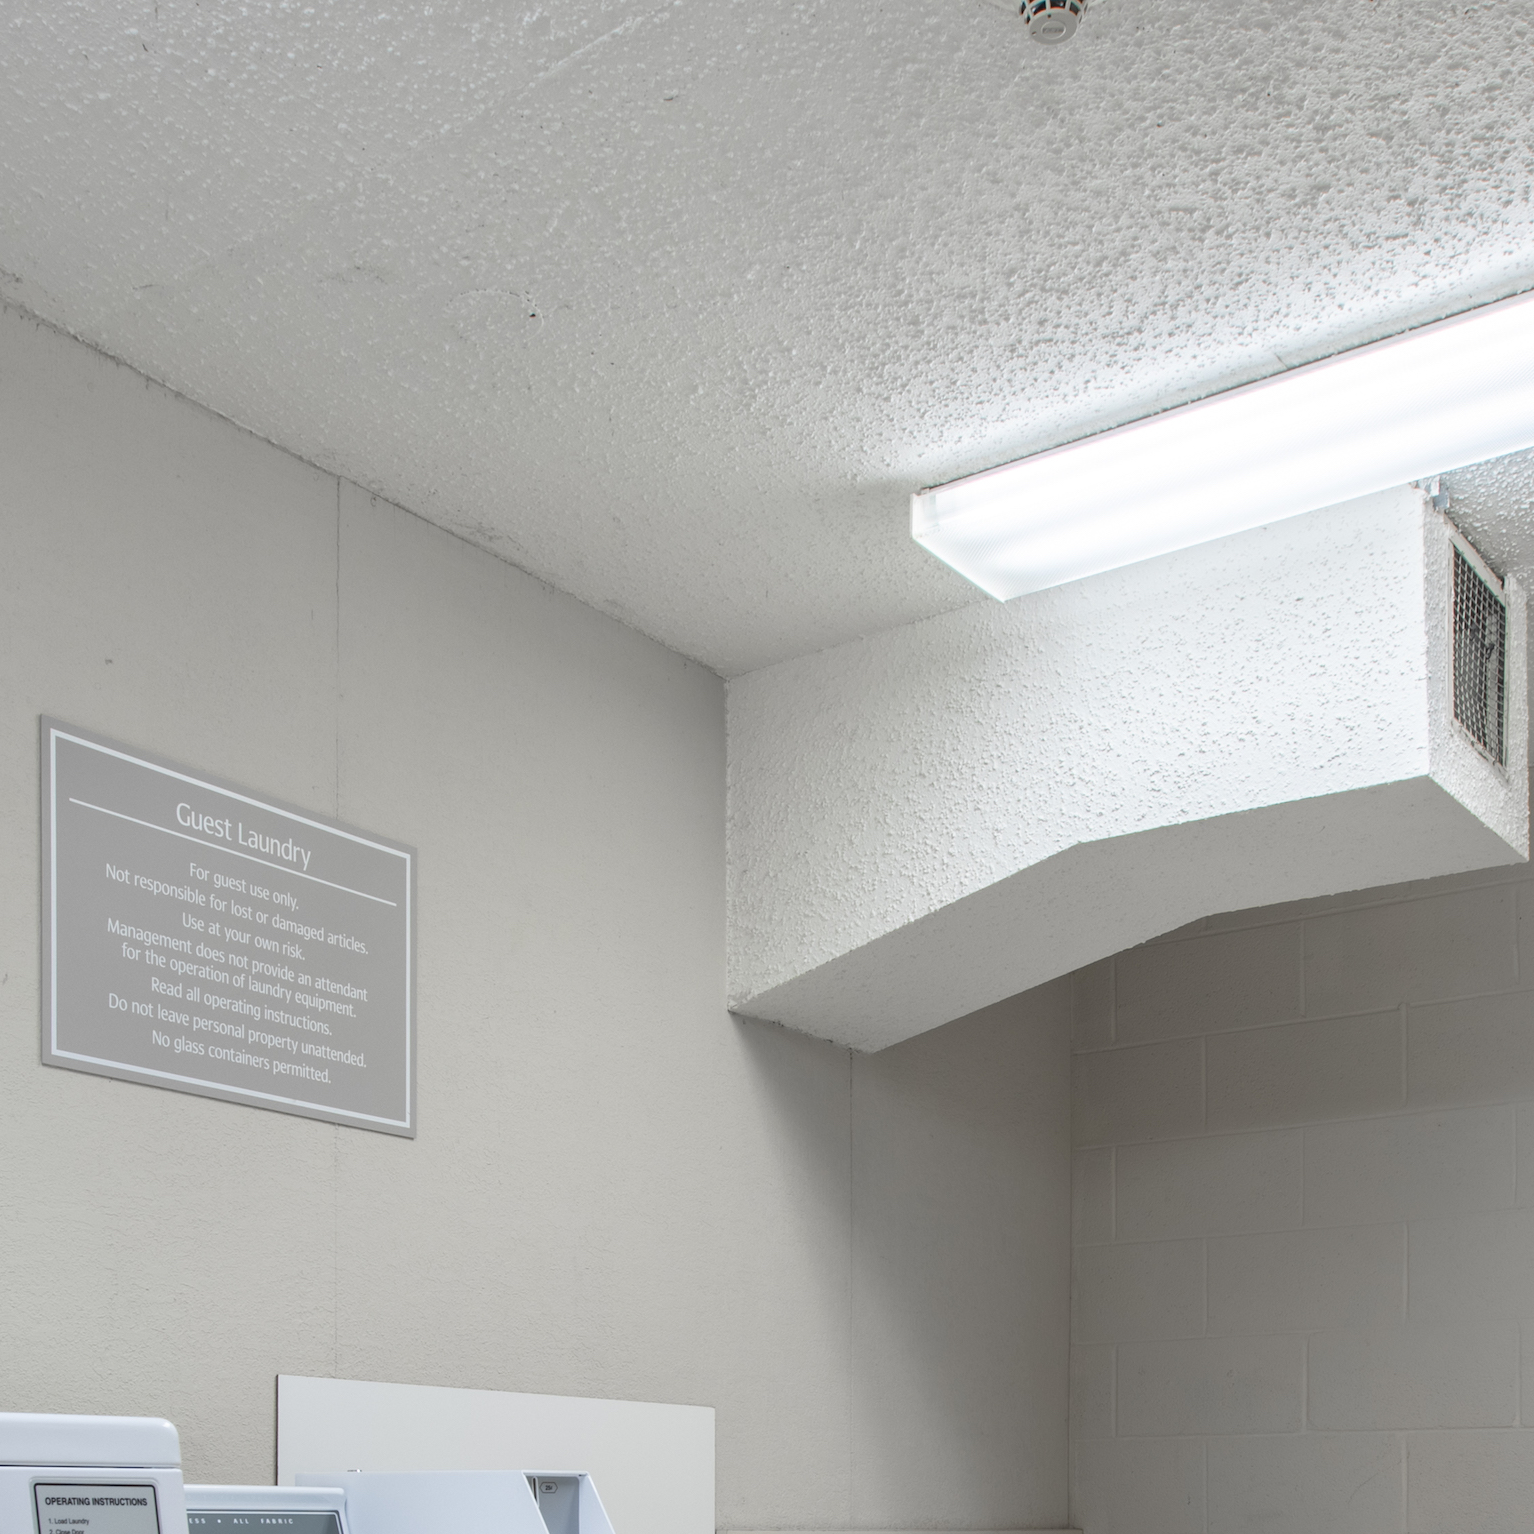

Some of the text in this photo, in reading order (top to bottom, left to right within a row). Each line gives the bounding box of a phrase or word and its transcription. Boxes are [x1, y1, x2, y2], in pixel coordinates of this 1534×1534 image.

[176, 802, 311, 871] Guest Laundry
[106, 862, 368, 954] Not responsible for lost or damaged articles.
[189, 862, 298, 911] For guest use only.
[107, 917, 367, 1002] Management does not provide an attendant
[182, 912, 305, 960] Use at your own risk.
[121, 942, 356, 1017] for the operation of laundry equipment.
[151, 976, 332, 1035] Read all operating instructions.
[108, 992, 366, 1067] Do not leave personal property unattended.
[152, 1029, 331, 1083] No glass containers permitted.
[44, 1496, 147, 1506] OPERATING INSTRUCTIONS
